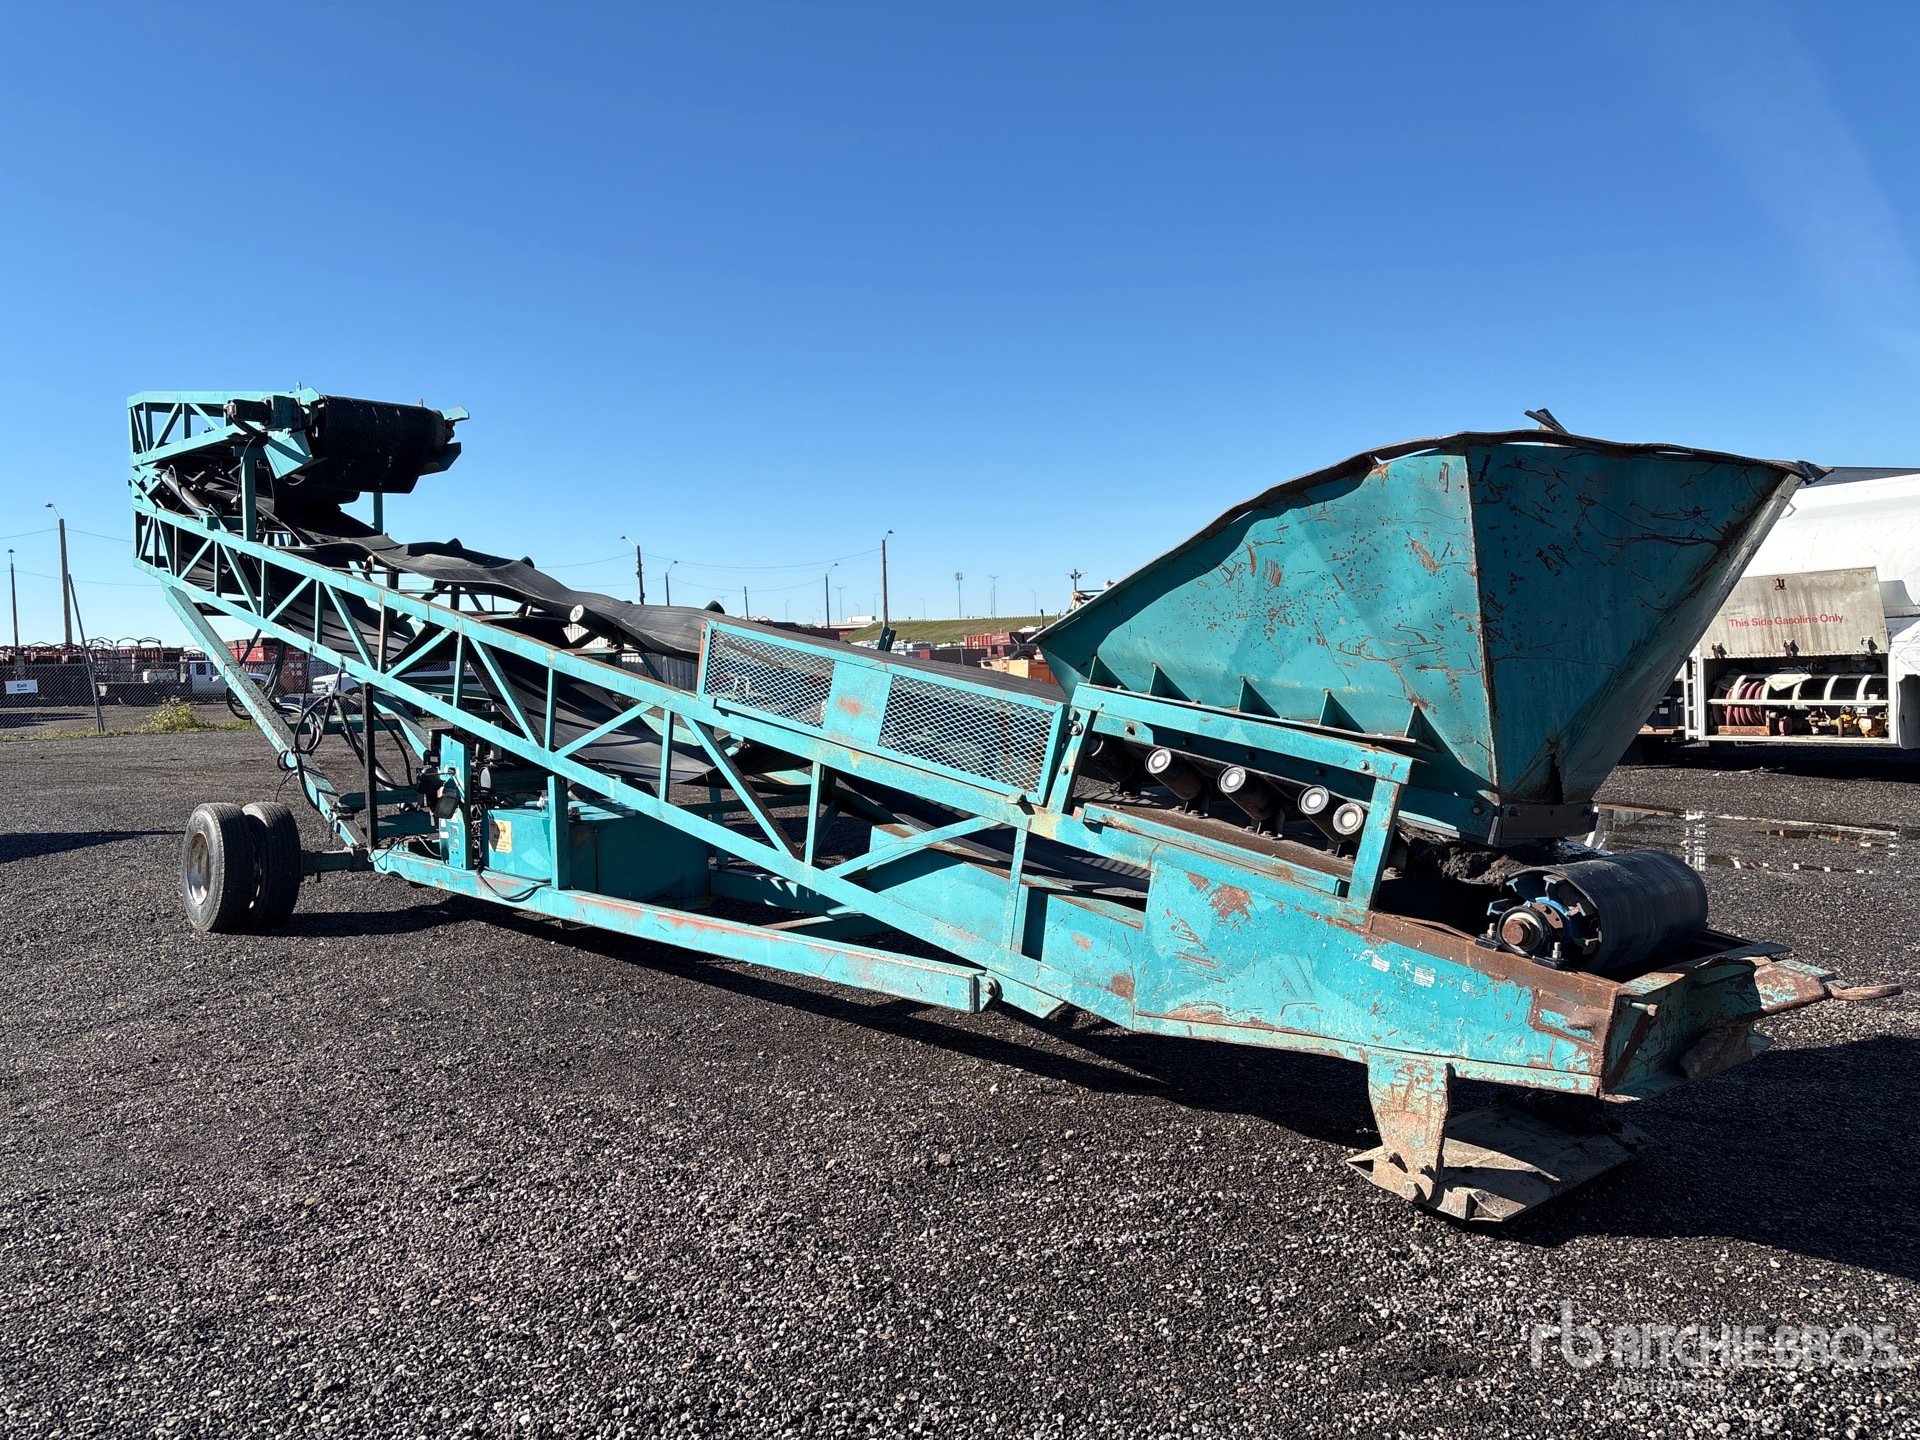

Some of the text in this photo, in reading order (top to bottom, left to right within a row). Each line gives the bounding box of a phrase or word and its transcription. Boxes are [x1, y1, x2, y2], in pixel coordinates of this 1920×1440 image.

[1729, 613, 1843, 627] This Side Gasoline Only
